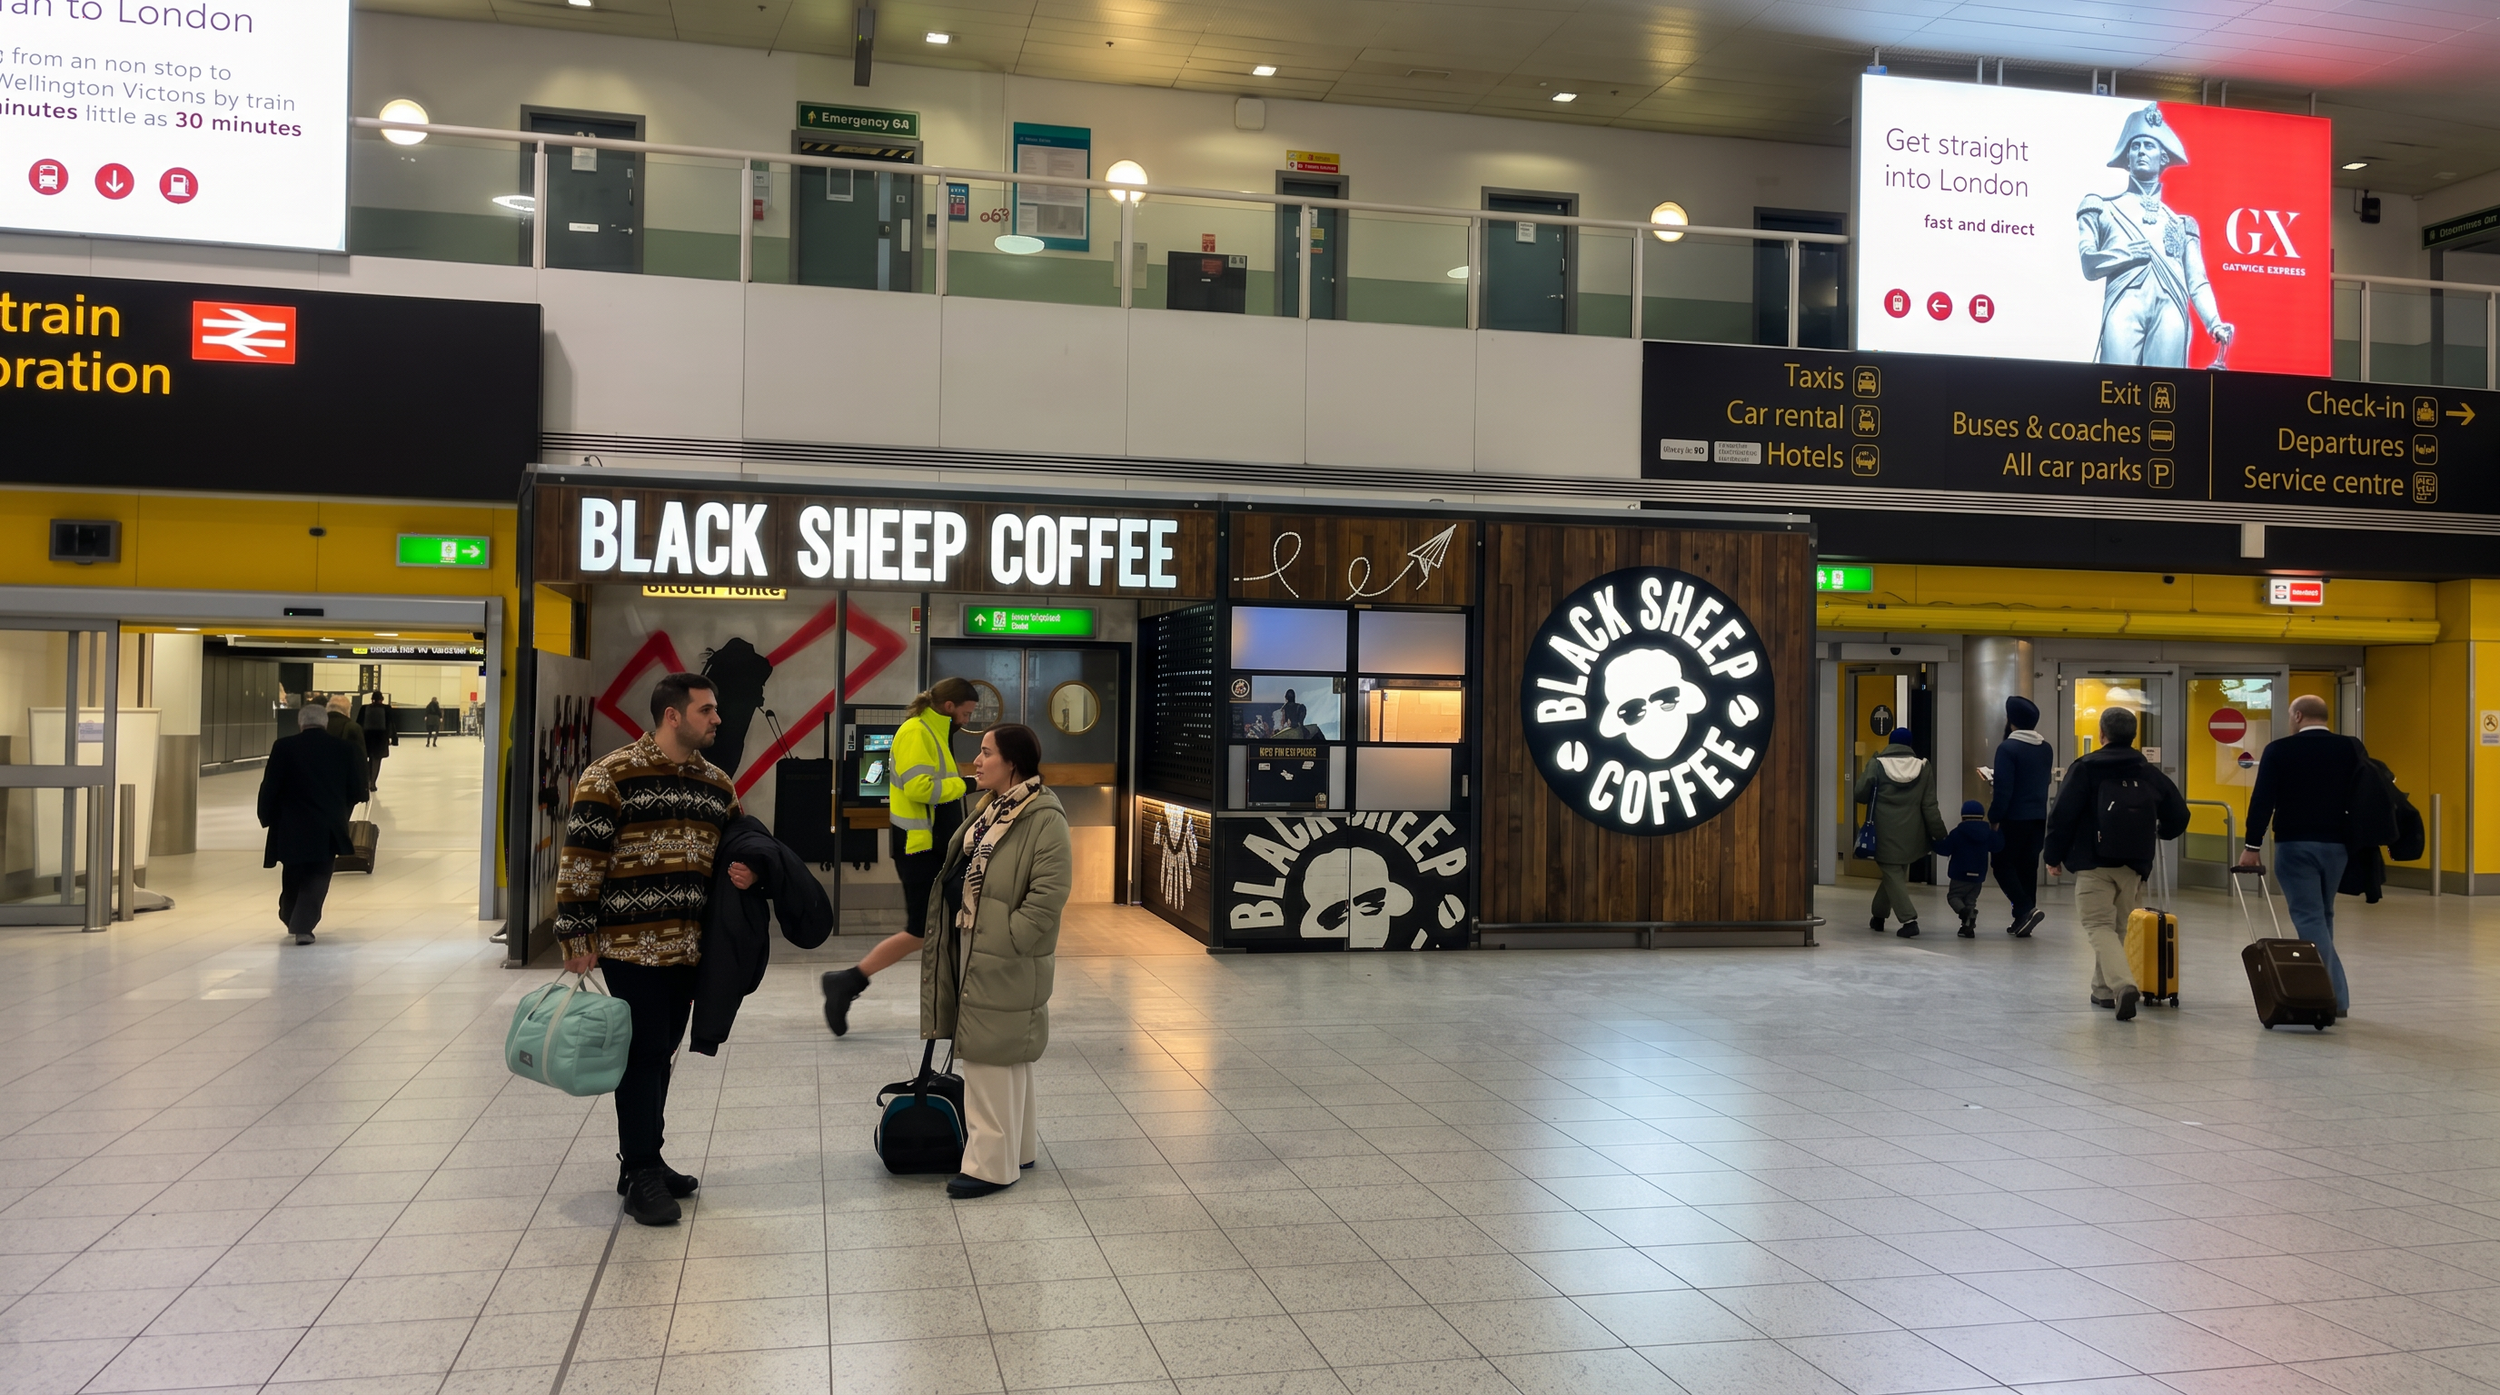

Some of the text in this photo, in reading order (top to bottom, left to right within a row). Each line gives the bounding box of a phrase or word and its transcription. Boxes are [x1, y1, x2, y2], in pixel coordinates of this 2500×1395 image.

[0, 0, 253, 33] an to London
[12, 47, 63, 68] from
[70, 55, 96, 70] an
[105, 58, 146, 75] non
[154, 61, 202, 82] stop
[210, 65, 231, 81] to
[123, 82, 206, 106] Victons
[214, 90, 239, 111] by
[246, 93, 296, 112] train
[0, 98, 302, 137] inutes little as 30 minutes
[821, 112, 889, 130] Emergency
[1886, 127, 2029, 165] Get straight
[1885, 163, 2028, 198] into London
[1924, 214, 2035, 237] fast and direct
[2225, 207, 2301, 258] GX
[2267, 266, 2306, 276] EXPRESS
[0, 292, 120, 338] train
[1784, 362, 1845, 390] Taxis
[2101, 380, 2142, 406] Exit
[2306, 390, 2406, 419] Check-in
[1726, 399, 1844, 429] Car rental
[1952, 411, 2142, 444] Buses & coaches
[1767, 441, 1844, 469] Hotels
[2278, 427, 2405, 459] Departures
[2002, 451, 2142, 485] All car parks
[2244, 465, 2404, 496] Service centre
[579, 497, 1178, 589] BLACK SHEEP COFFEE
[1536, 576, 1759, 723] BLACK SHEEP
[1588, 725, 1756, 826] COFFEE
